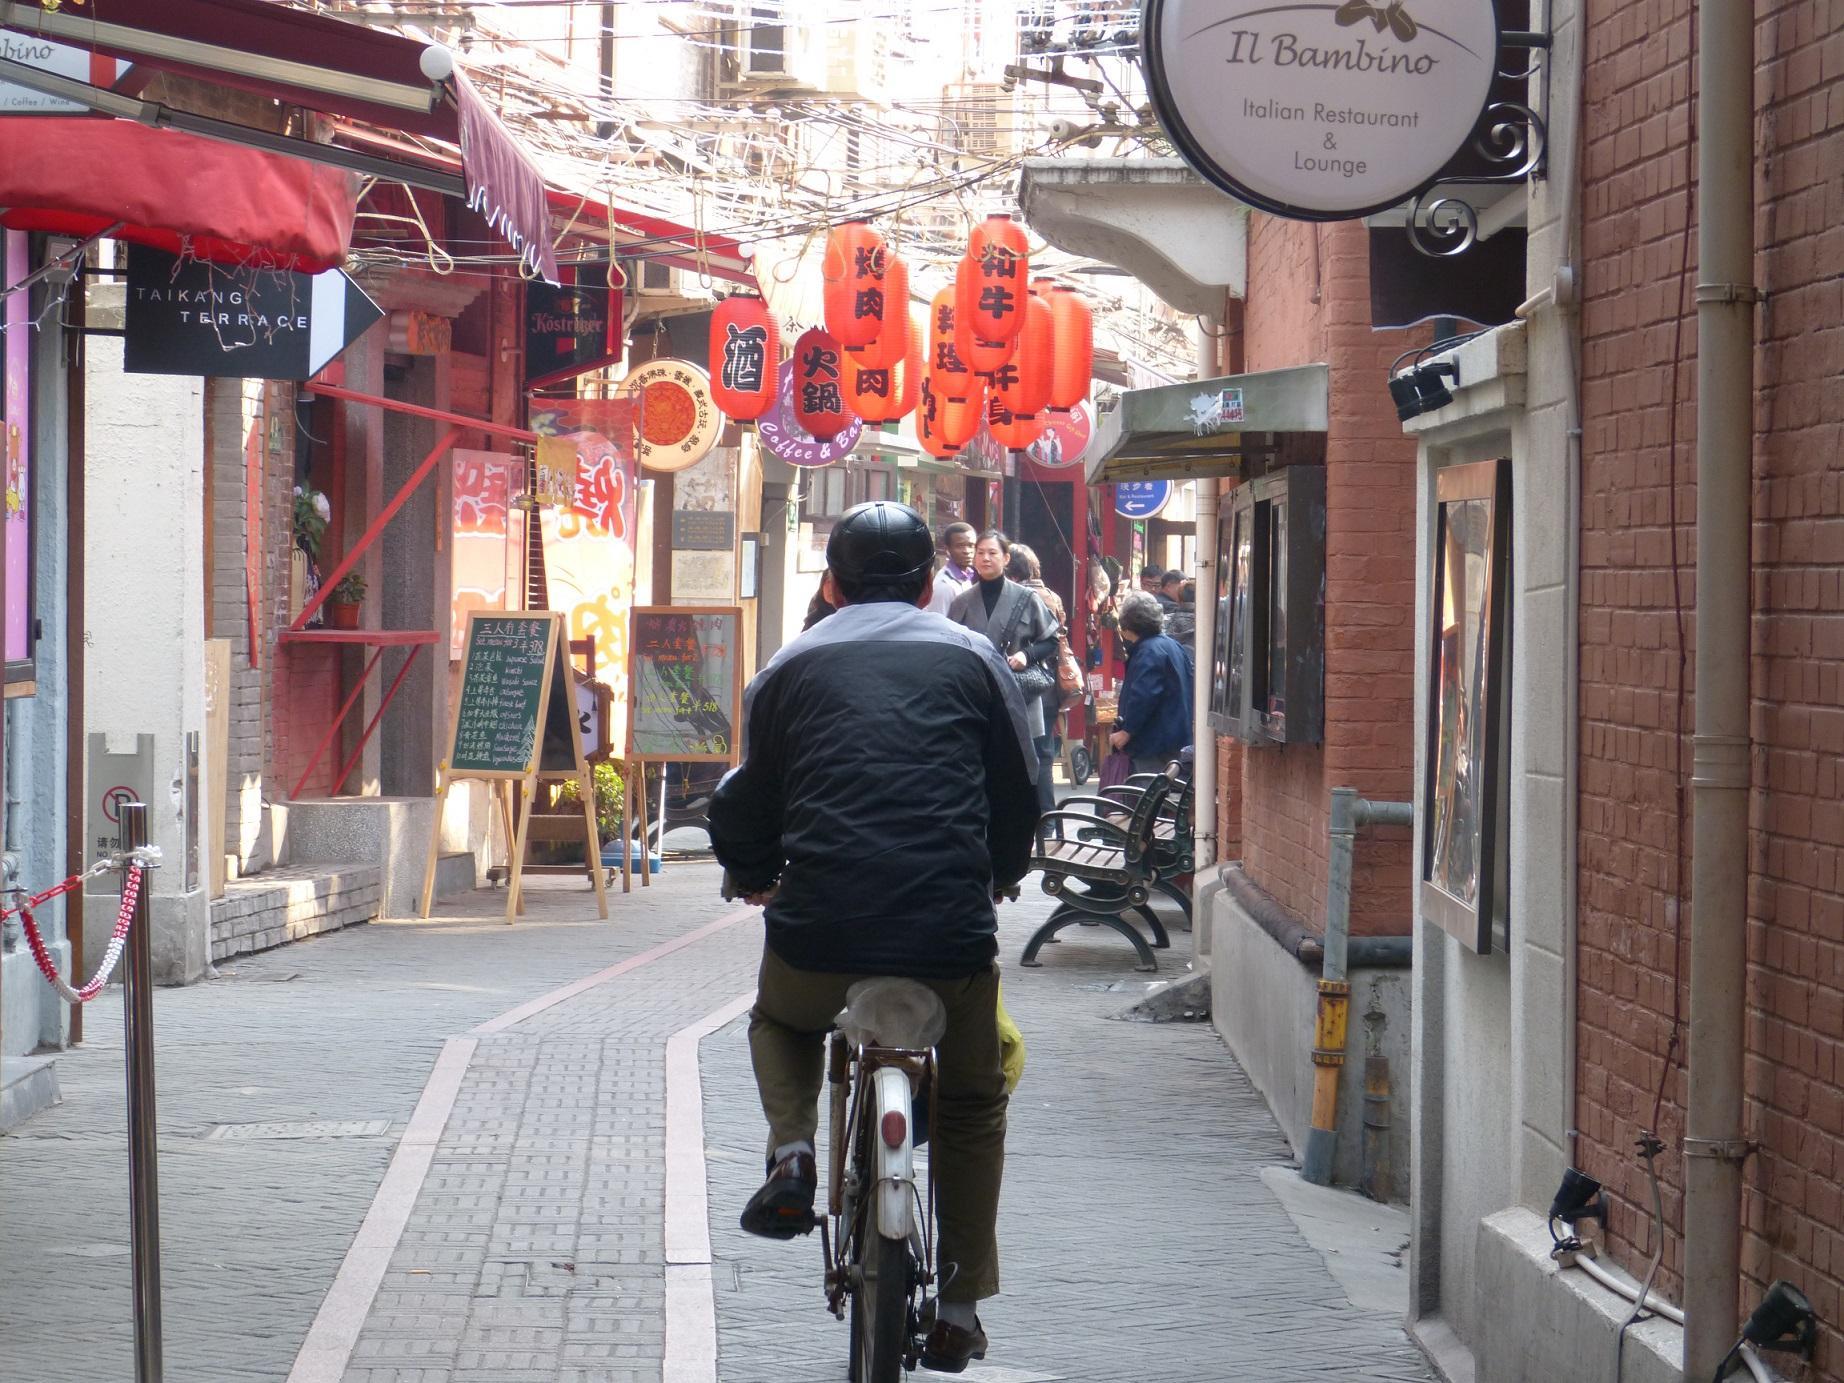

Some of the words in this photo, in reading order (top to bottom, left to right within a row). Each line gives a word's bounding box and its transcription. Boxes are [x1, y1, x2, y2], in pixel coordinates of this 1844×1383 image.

[0, 38, 55, 60] bino
[1226, 30, 1263, 64] Il
[1271, 33, 1439, 75] Bambino
[11, 97, 38, 106] Coffee
[1243, 98, 1304, 121] Italian
[1314, 103, 1419, 128] Restaurant
[1323, 132, 1337, 150] &
[1295, 151, 1367, 178] Lounge
[136, 287, 242, 304] TAIKANG
[979, 244, 1016, 319] 和牛
[180, 311, 308, 328] TERRACE
[721, 323, 768, 392] 酒
[802, 346, 842, 415] 火鍋
[855, 369, 889, 397] 肉
[760, 422, 813, 459] Coffee
[820, 443, 831, 458] &
